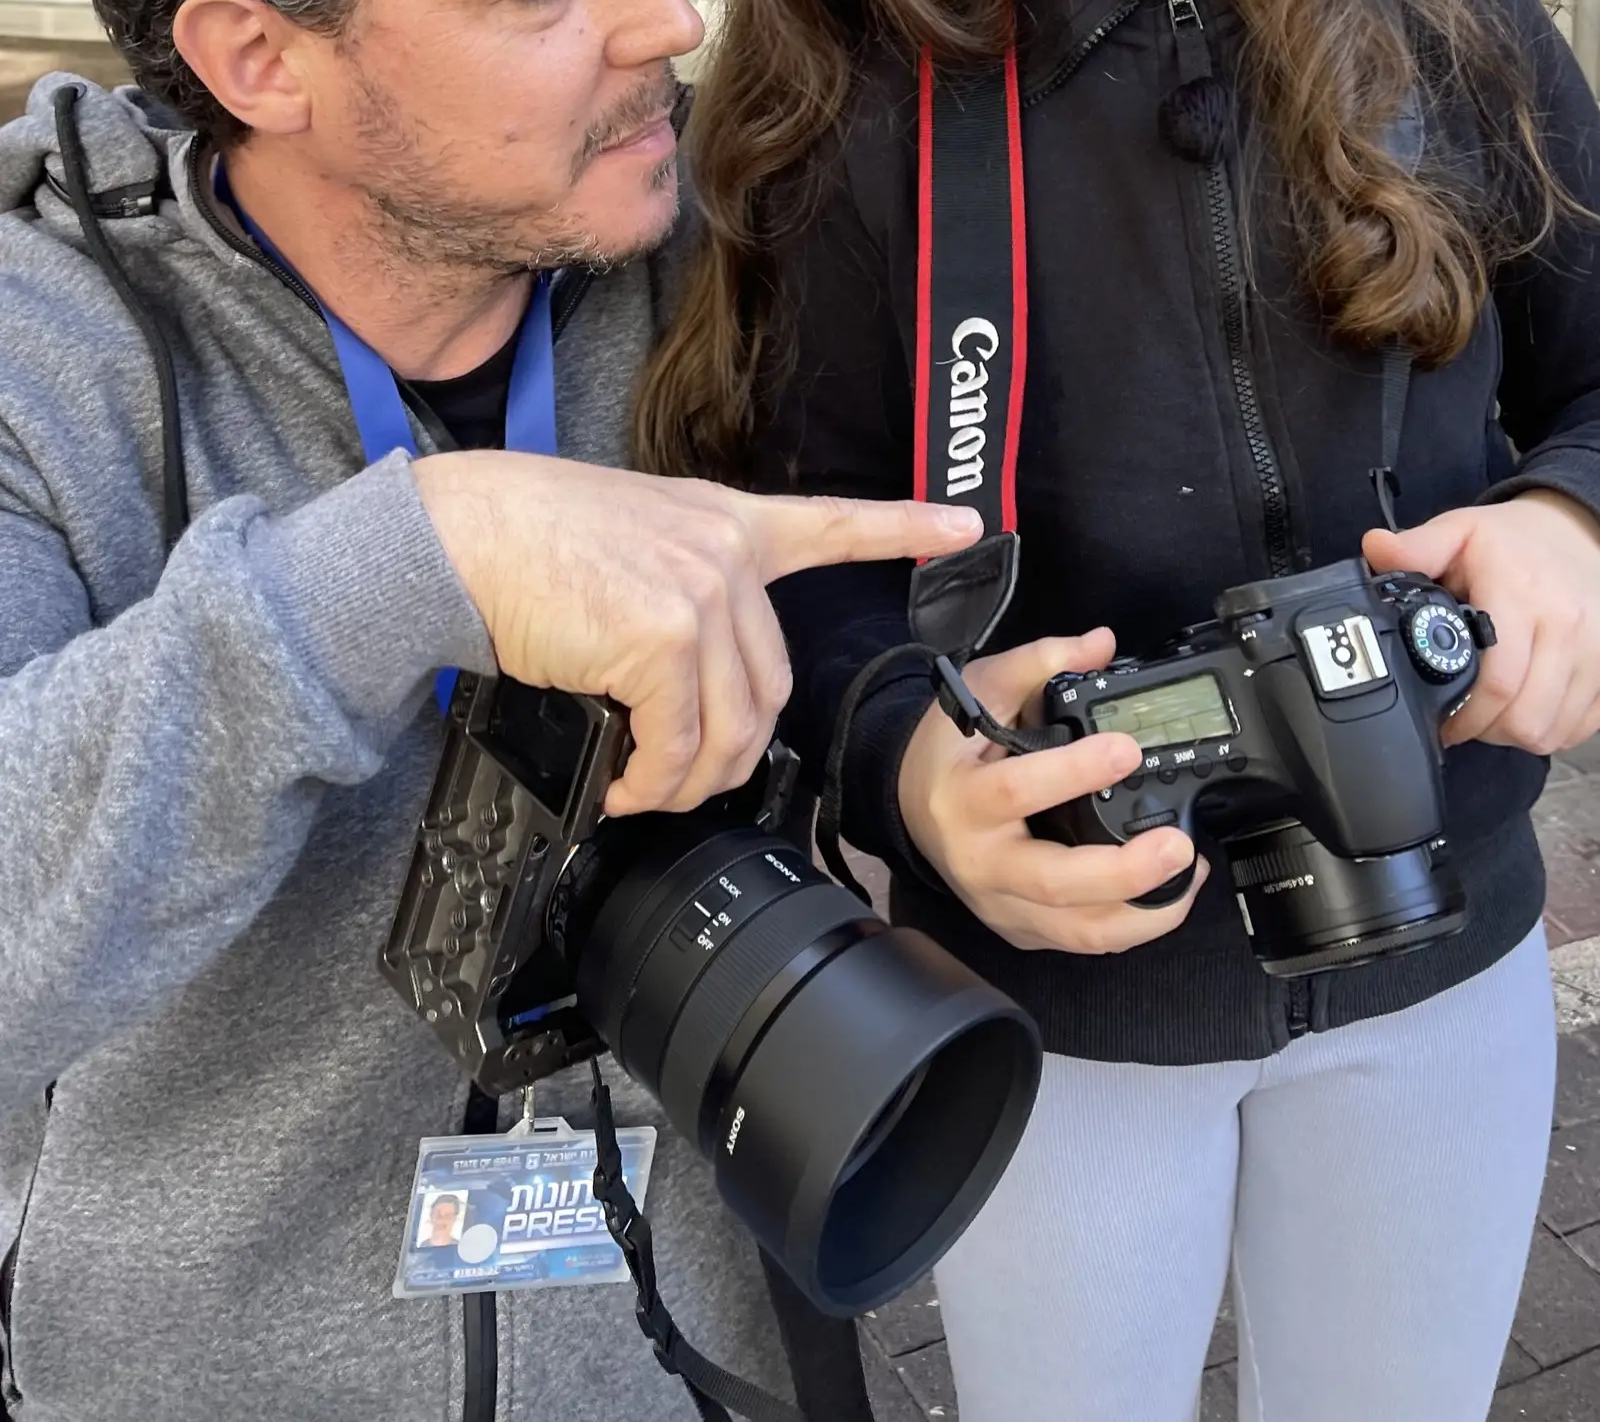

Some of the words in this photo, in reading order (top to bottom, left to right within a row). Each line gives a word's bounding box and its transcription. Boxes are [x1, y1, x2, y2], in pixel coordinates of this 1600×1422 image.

[947, 317, 1000, 497] Canon
[1145, 756, 1160, 768] ISO
[1174, 749, 1195, 764] DRIVE
[765, 853, 801, 883] SONY
[719, 876, 742, 899] CLICK
[718, 912, 732, 926] ON
[697, 934, 714, 952] OFF
[726, 1106, 745, 1155] SONY
[506, 1176, 628, 1212] תונות
